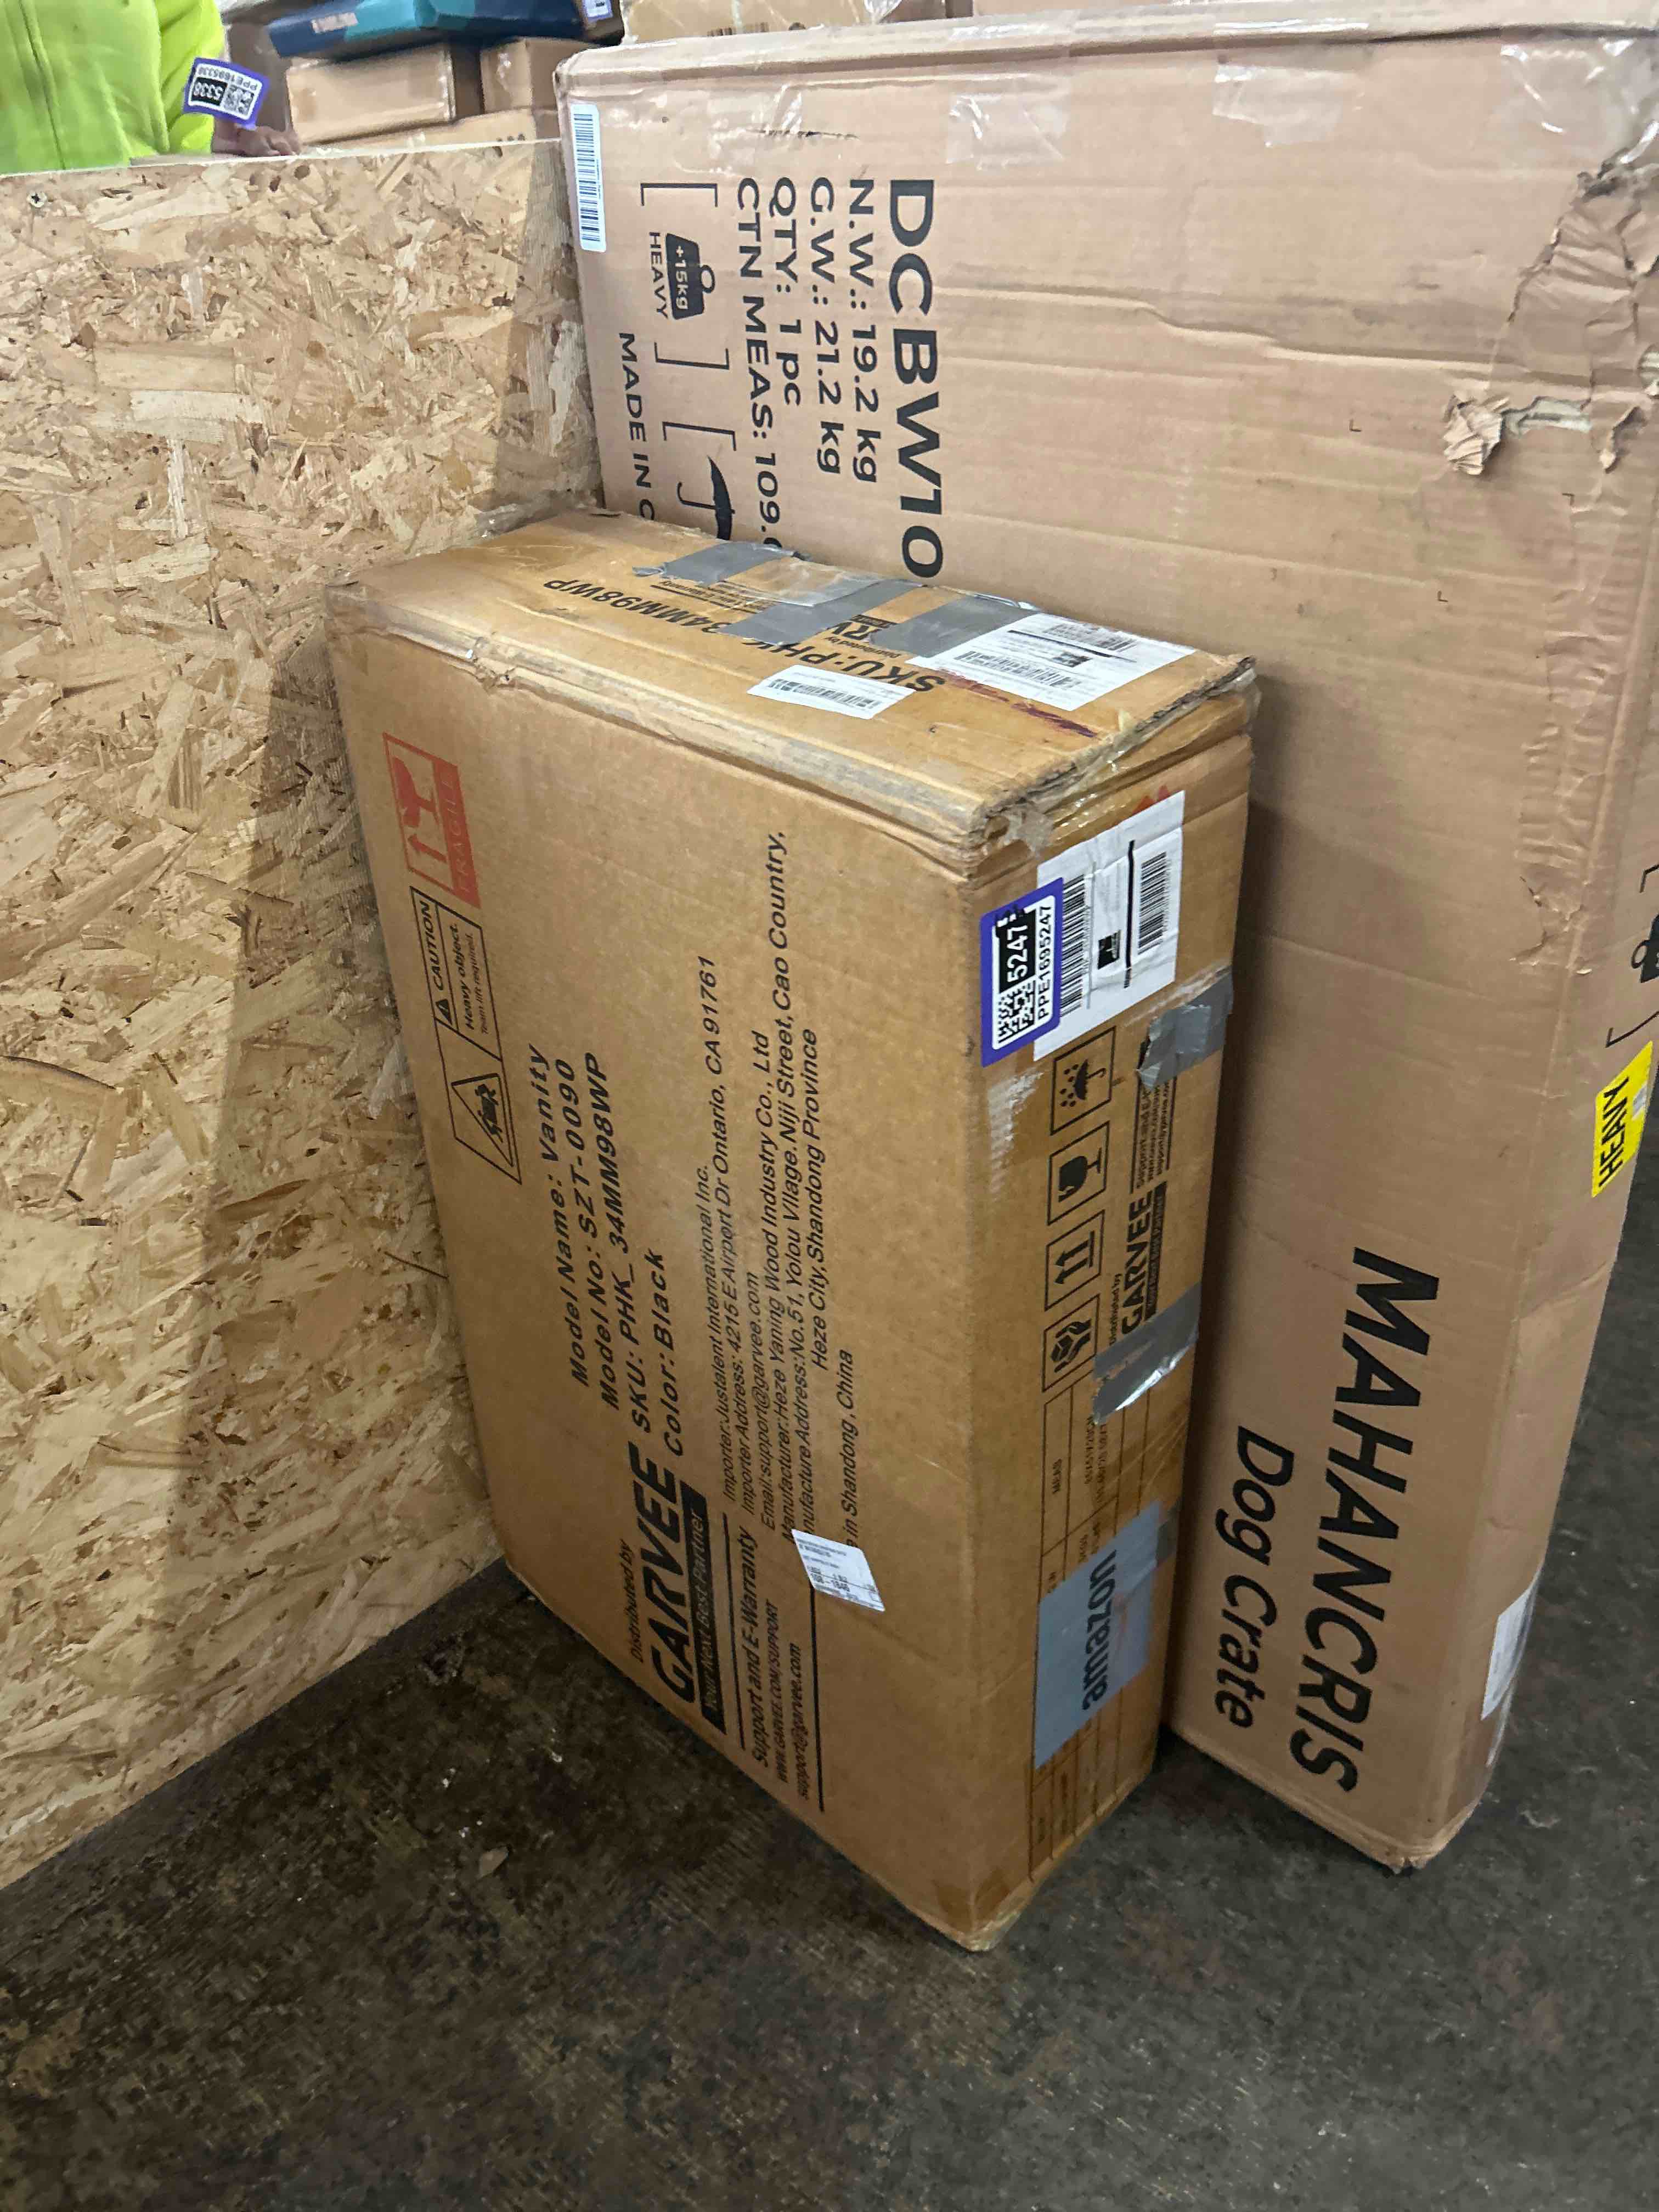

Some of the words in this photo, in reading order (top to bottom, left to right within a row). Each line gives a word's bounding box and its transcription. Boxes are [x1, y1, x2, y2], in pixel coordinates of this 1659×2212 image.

[737, 177, 763, 279] CTN
[769, 177, 798, 294] QTY:
[810, 177, 837, 306] G.W.:
[848, 179, 876, 310] N.W.:
[648, 231, 669, 320] HEAVY
[741, 296, 774, 441] MEAS:
[778, 318, 803, 335] 1
[813, 321, 842, 405] 21.2
[852, 325, 879, 413] 19.2
[618, 332, 647, 443] MADE
[634, 453, 653, 490] IN
[775, 351, 802, 407] pc
[816, 422, 846, 476] kg
[854, 428, 882, 484] kg
[766, 832, 787, 949] Country,
[420, 900, 444, 991] CAUTION
[773, 957, 791, 1011] Cao
[1007, 924, 1028, 983] 5247
[1039, 906, 1052, 1020] PPE1695247
[461, 980, 475, 1030] Heavy
[698, 956, 720, 1035] 91761
[706, 1041, 722, 1075] CA
[751, 1030, 771, 1074] Ltd
[775, 1015, 795, 1098] Street,
[800, 1029, 821, 1141] Province
[528, 1043, 559, 1161] Vanity
[709, 1085, 729, 1175] Ontario,
[1599, 1075, 1630, 1189] HEAVY
[555, 1059, 598, 1238] SZT-0090
[695, 1165, 710, 1203] Inc.
[714, 1177, 731, 1207] Dr
[758, 1131, 778, 1227] Industry
[547, 1173, 575, 1284] Name:
[718, 1209, 738, 1284] Airport
[804, 1144, 826, 1263] Shandong
[586, 1245, 606, 1305] No:
[644, 1247, 674, 1351] Black
[695, 1204, 721, 1335] International
[761, 1228, 781, 1292] Wood
[785, 1227, 803, 1287] Yolou
[808, 1265, 830, 1311] City,
[1121, 1190, 1153, 1335] GARVEE
[560, 1286, 589, 1387] Model
[590, 1307, 619, 1410] Model
[724, 1301, 741, 1353] 4215
[767, 1296, 786, 1364] Yaning
[810, 1316, 829, 1371] Heze
[625, 1351, 651, 1433] SKU:
[659, 1352, 684, 1457] Color:
[731, 1356, 749, 1441] Address:
[836, 1349, 854, 1409] China
[738, 1440, 757, 1515] Importer
[798, 1445, 816, 1535] nufacture
[1214, 1426, 1295, 1565] Dog
[1289, 1246, 1440, 1794] MAHANCRIS
[619, 1538, 635, 1562] by
[628, 1440, 695, 1703] GARVEE
[690, 1509, 707, 1585] Partner
[738, 1524, 760, 1649] E-Warranty
[620, 1563, 644, 1663] Distributed
[1081, 1549, 1117, 1713] amazon
[1215, 1573, 1278, 1730] Crate
[742, 1644, 762, 1690] and
[747, 1688, 771, 1768] Support
